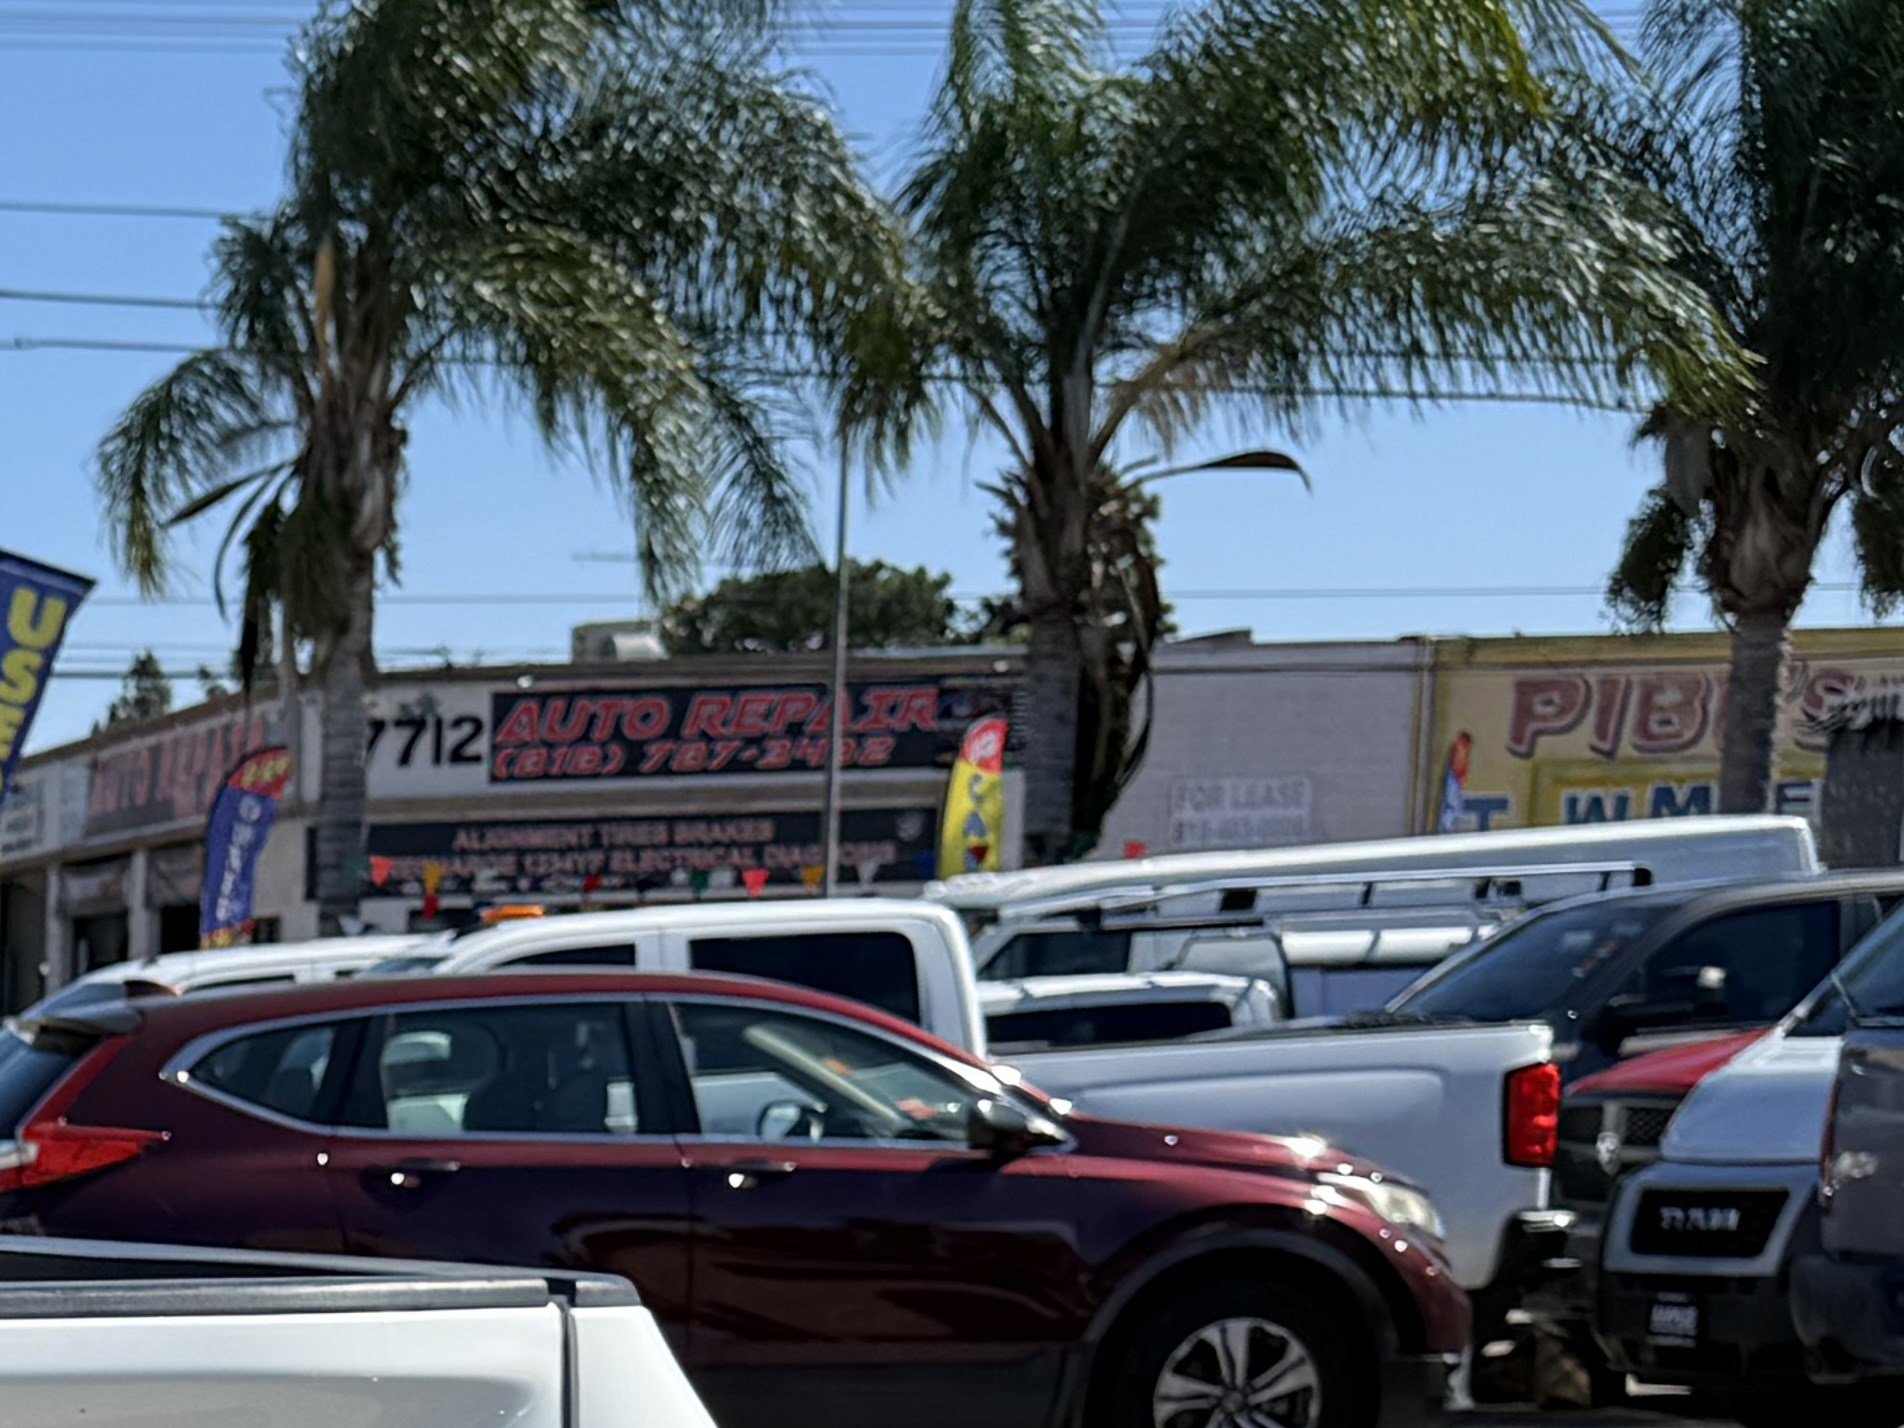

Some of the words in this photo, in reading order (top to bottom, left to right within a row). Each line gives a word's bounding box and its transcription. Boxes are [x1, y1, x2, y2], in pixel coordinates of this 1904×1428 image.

[492, 696, 672, 745] AUTO
[679, 686, 940, 739] REPAIR
[1660, 1206, 1741, 1231] RAM
